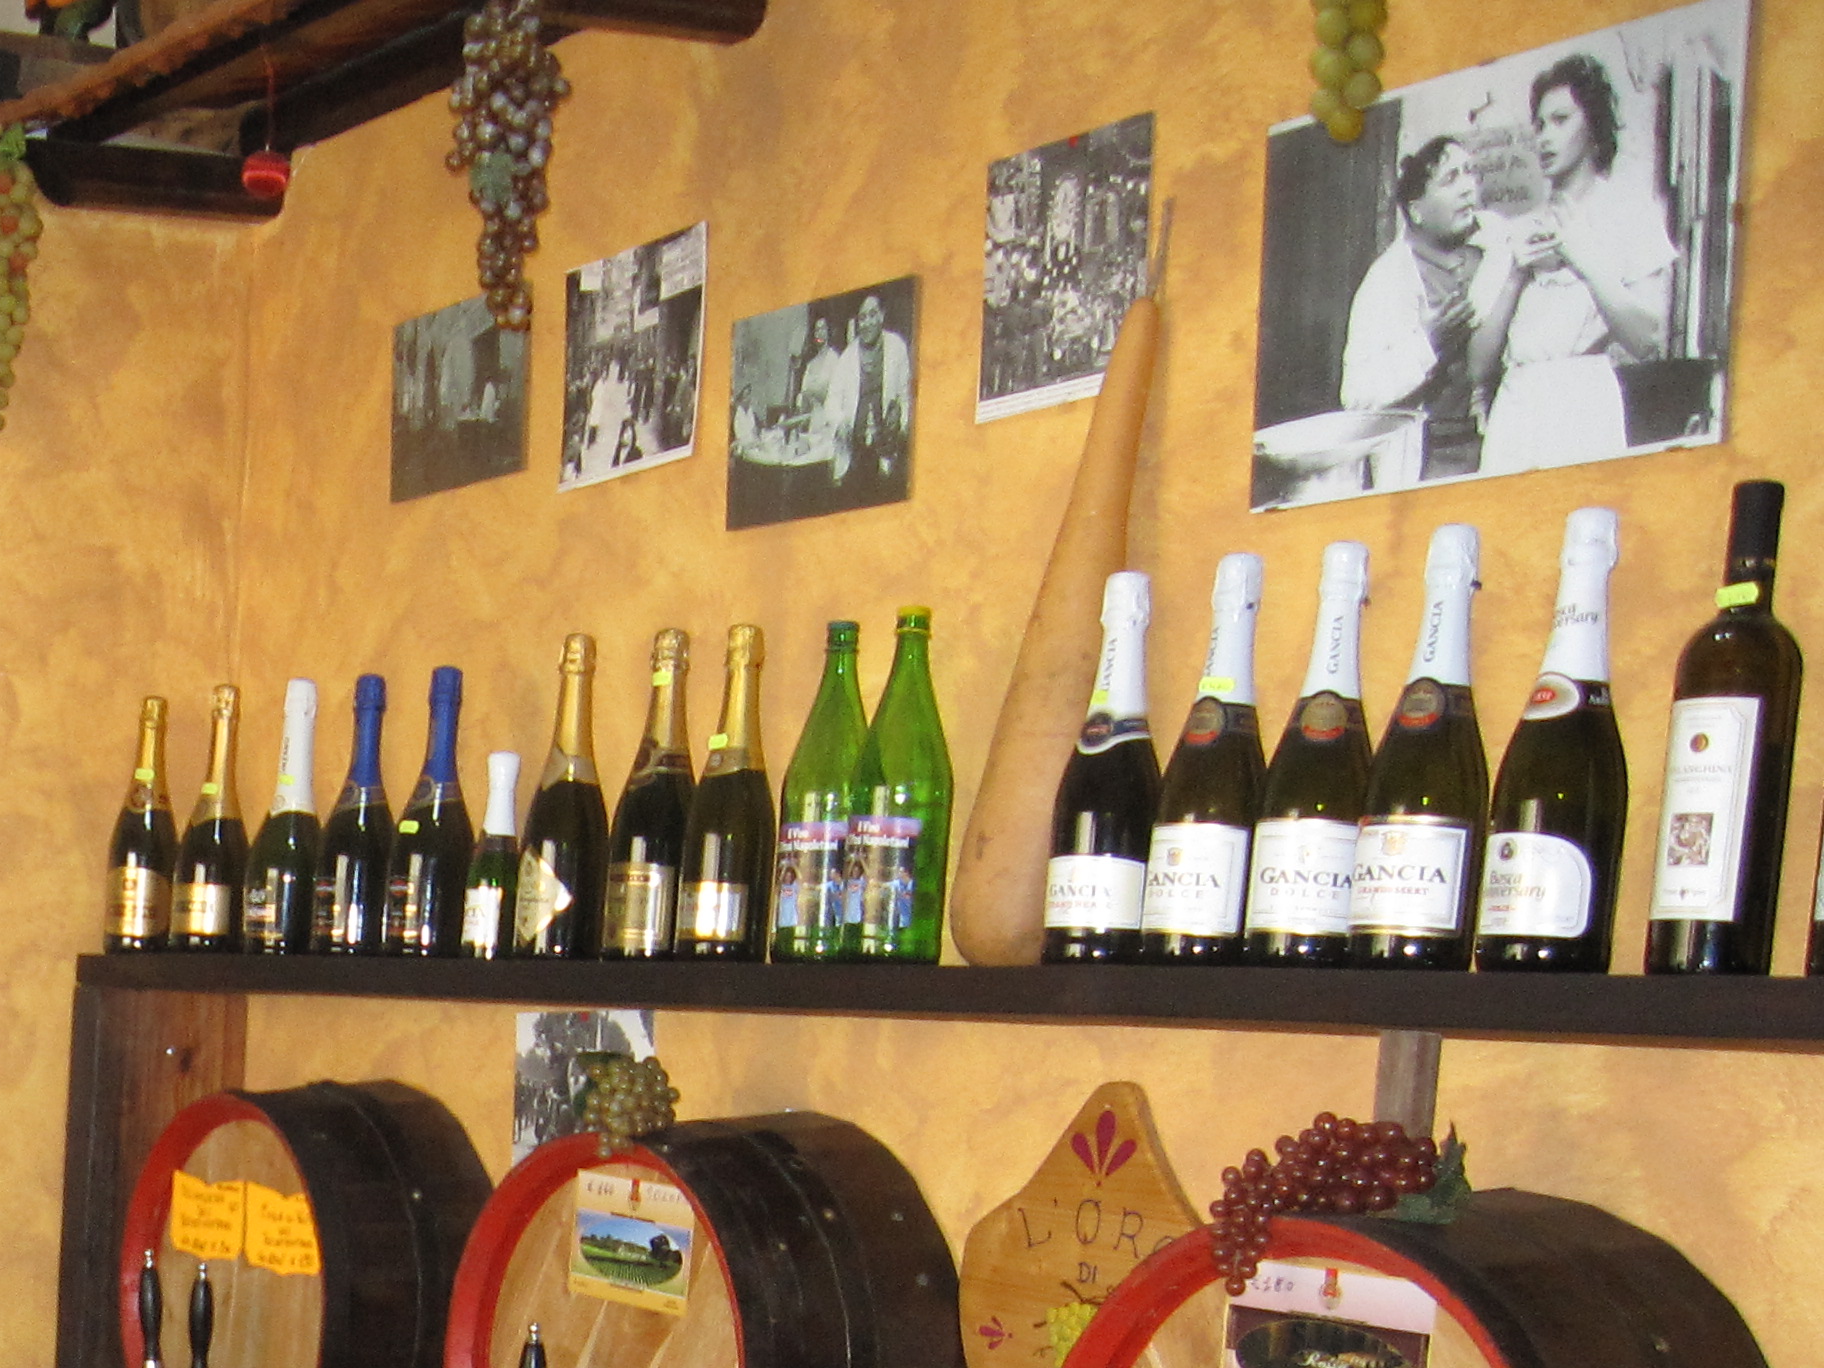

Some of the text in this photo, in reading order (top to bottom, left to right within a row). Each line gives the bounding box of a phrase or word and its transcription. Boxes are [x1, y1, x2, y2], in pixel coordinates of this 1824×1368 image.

[1423, 600, 1444, 663] GANCIA
[1327, 614, 1345, 675] GANCIA
[1259, 867, 1353, 890] GANCIA
[1352, 863, 1447, 885] GANCIA
[1078, 1261, 1098, 1285] DI
